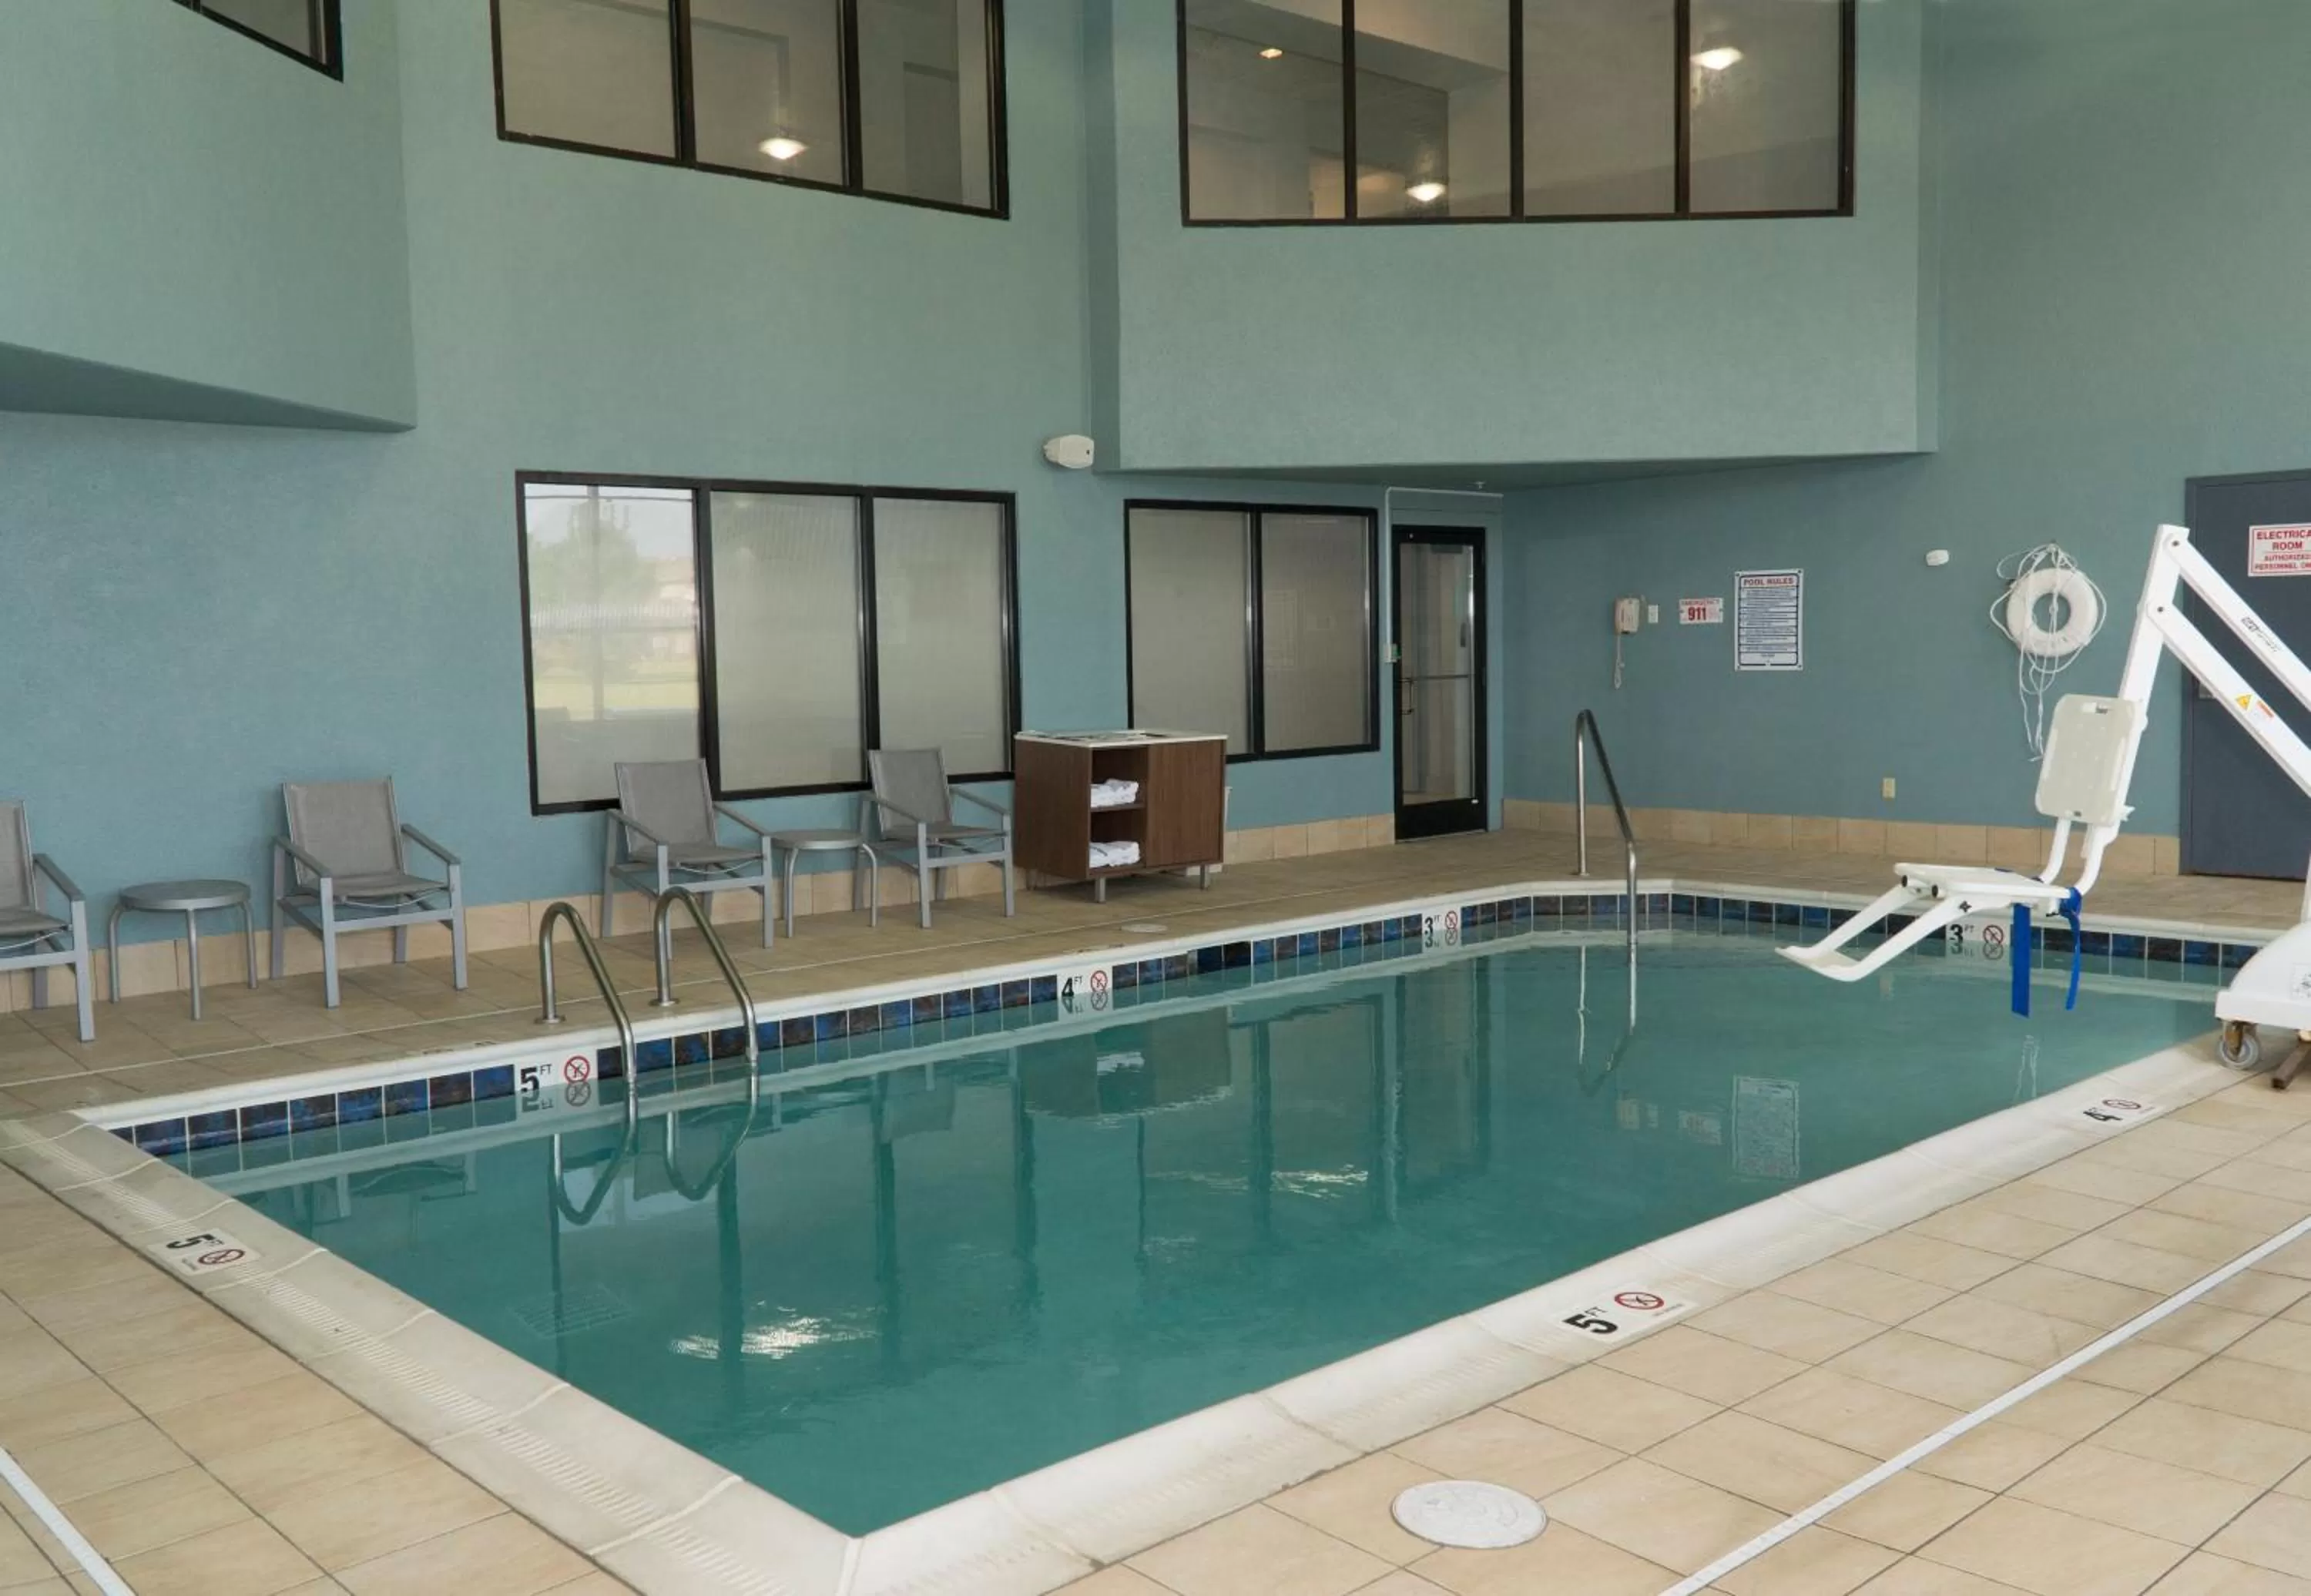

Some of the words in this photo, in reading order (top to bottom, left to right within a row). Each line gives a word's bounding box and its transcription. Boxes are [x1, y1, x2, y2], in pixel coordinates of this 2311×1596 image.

[2272, 541, 2303, 551] ROOM
[1688, 606, 1706, 621] 911
[1425, 917, 1433, 934] 3
[1950, 924, 1963, 944] 3
[1062, 977, 1075, 998] 4
[520, 1066, 539, 1092] 5
[540, 1064, 553, 1075] FT
[166, 1233, 216, 1249] 5
[1562, 1313, 1618, 1334] 5
